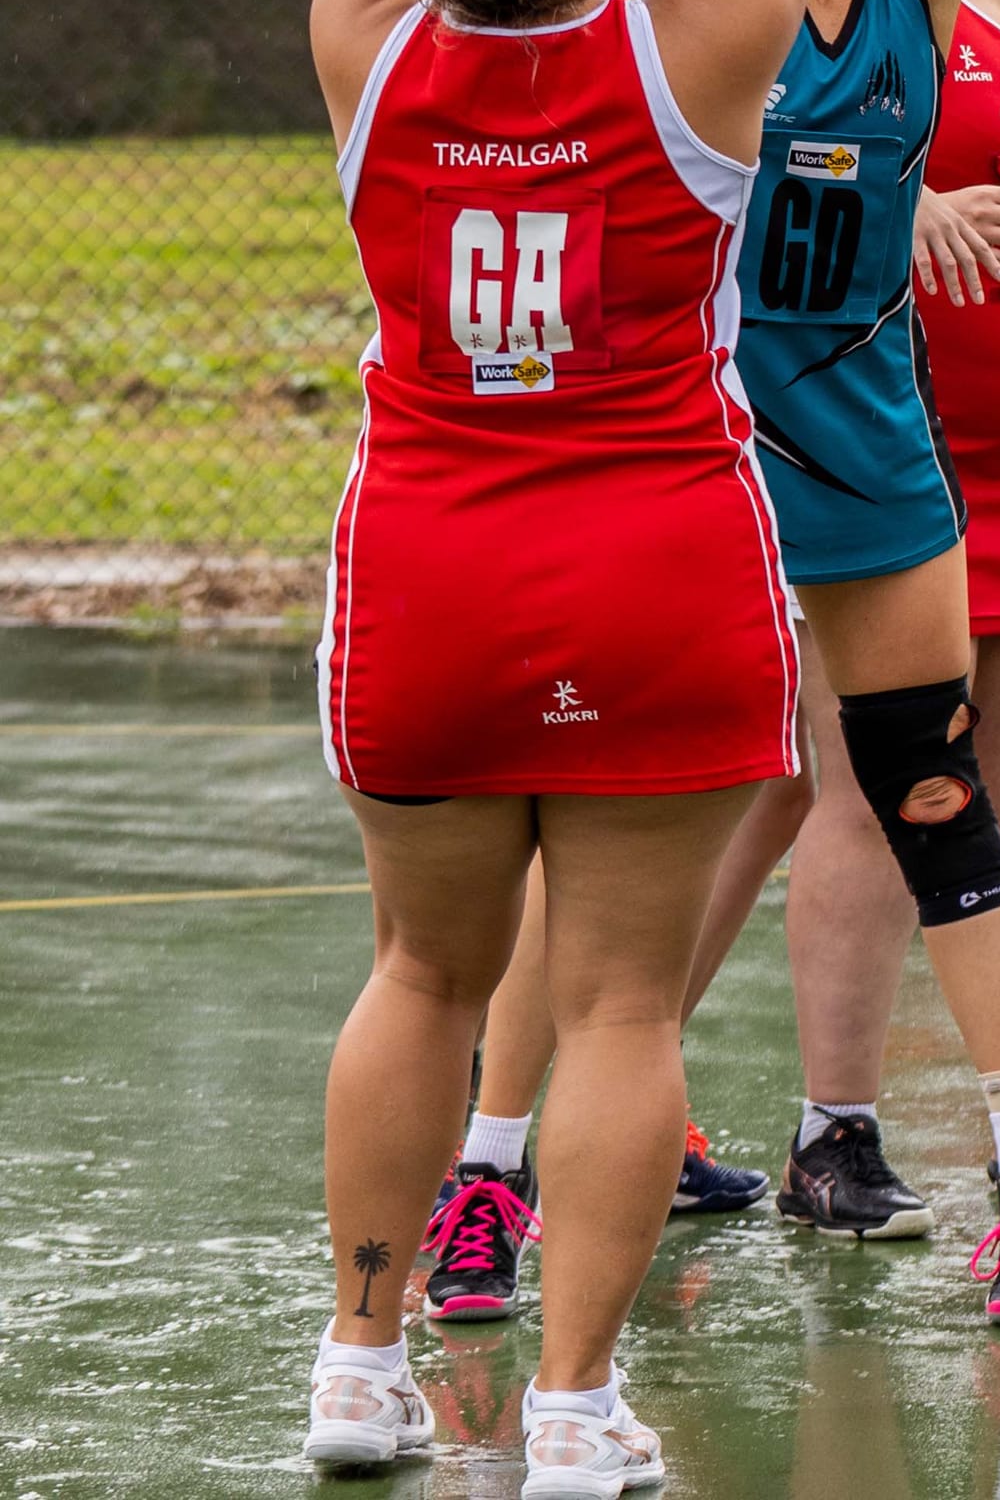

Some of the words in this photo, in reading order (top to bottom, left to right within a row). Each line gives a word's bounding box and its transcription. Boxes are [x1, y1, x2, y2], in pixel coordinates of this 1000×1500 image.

[953, 70, 993, 82] KUKRI
[433, 141, 588, 167] TRAFALGAR
[794, 152, 852, 167] WorkSafe
[758, 178, 864, 312] GD
[450, 208, 574, 357] GA
[480, 364, 545, 379] WorkSafe
[542, 709, 599, 725] KUKRI
